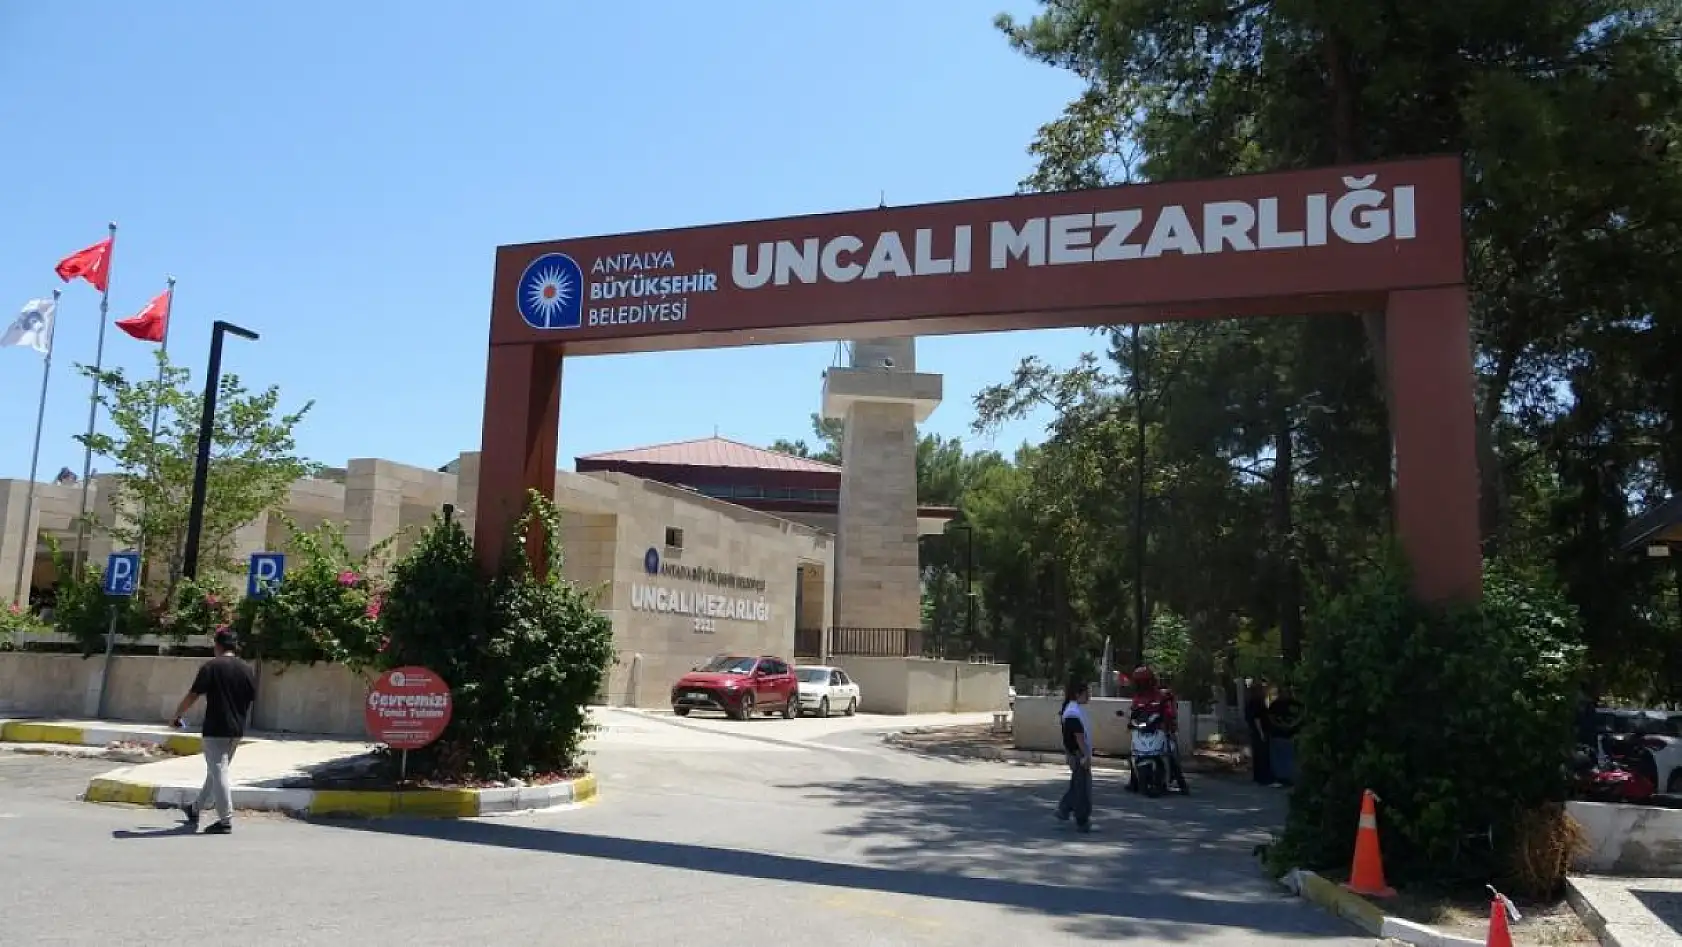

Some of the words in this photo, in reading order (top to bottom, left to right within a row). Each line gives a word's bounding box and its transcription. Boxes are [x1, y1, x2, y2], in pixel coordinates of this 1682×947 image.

[731, 225, 972, 290] UNCALI
[990, 174, 1417, 270] MEZARLIĞI
[591, 250, 675, 274] ANTALYA
[590, 268, 718, 299] BÜYÜKŞEHİR
[588, 298, 687, 326] BELEDİYESİ
[111, 557, 131, 590] P
